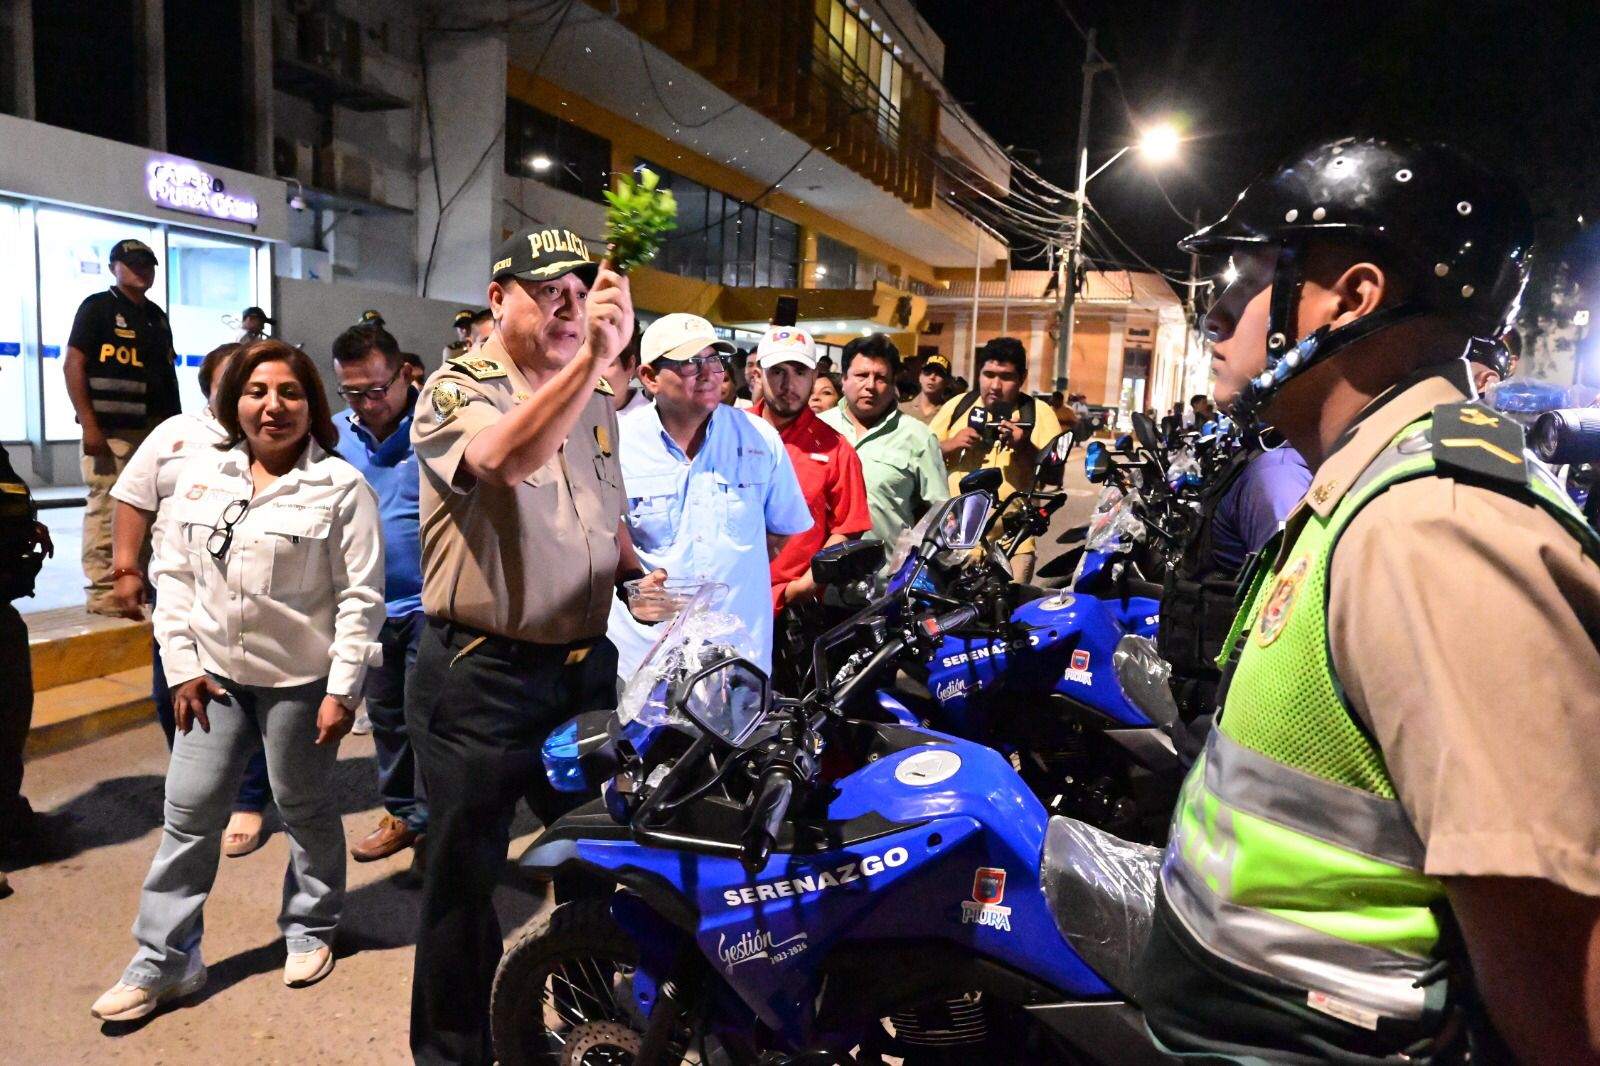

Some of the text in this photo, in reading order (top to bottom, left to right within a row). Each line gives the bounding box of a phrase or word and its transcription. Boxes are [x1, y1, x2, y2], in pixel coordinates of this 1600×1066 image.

[100, 343, 144, 368] POL
[723, 846, 909, 907] SERENAZGO
[961, 906, 1011, 931] PIURA
[718, 929, 790, 974] Gestión
[769, 942, 808, 965] 2023-2026
